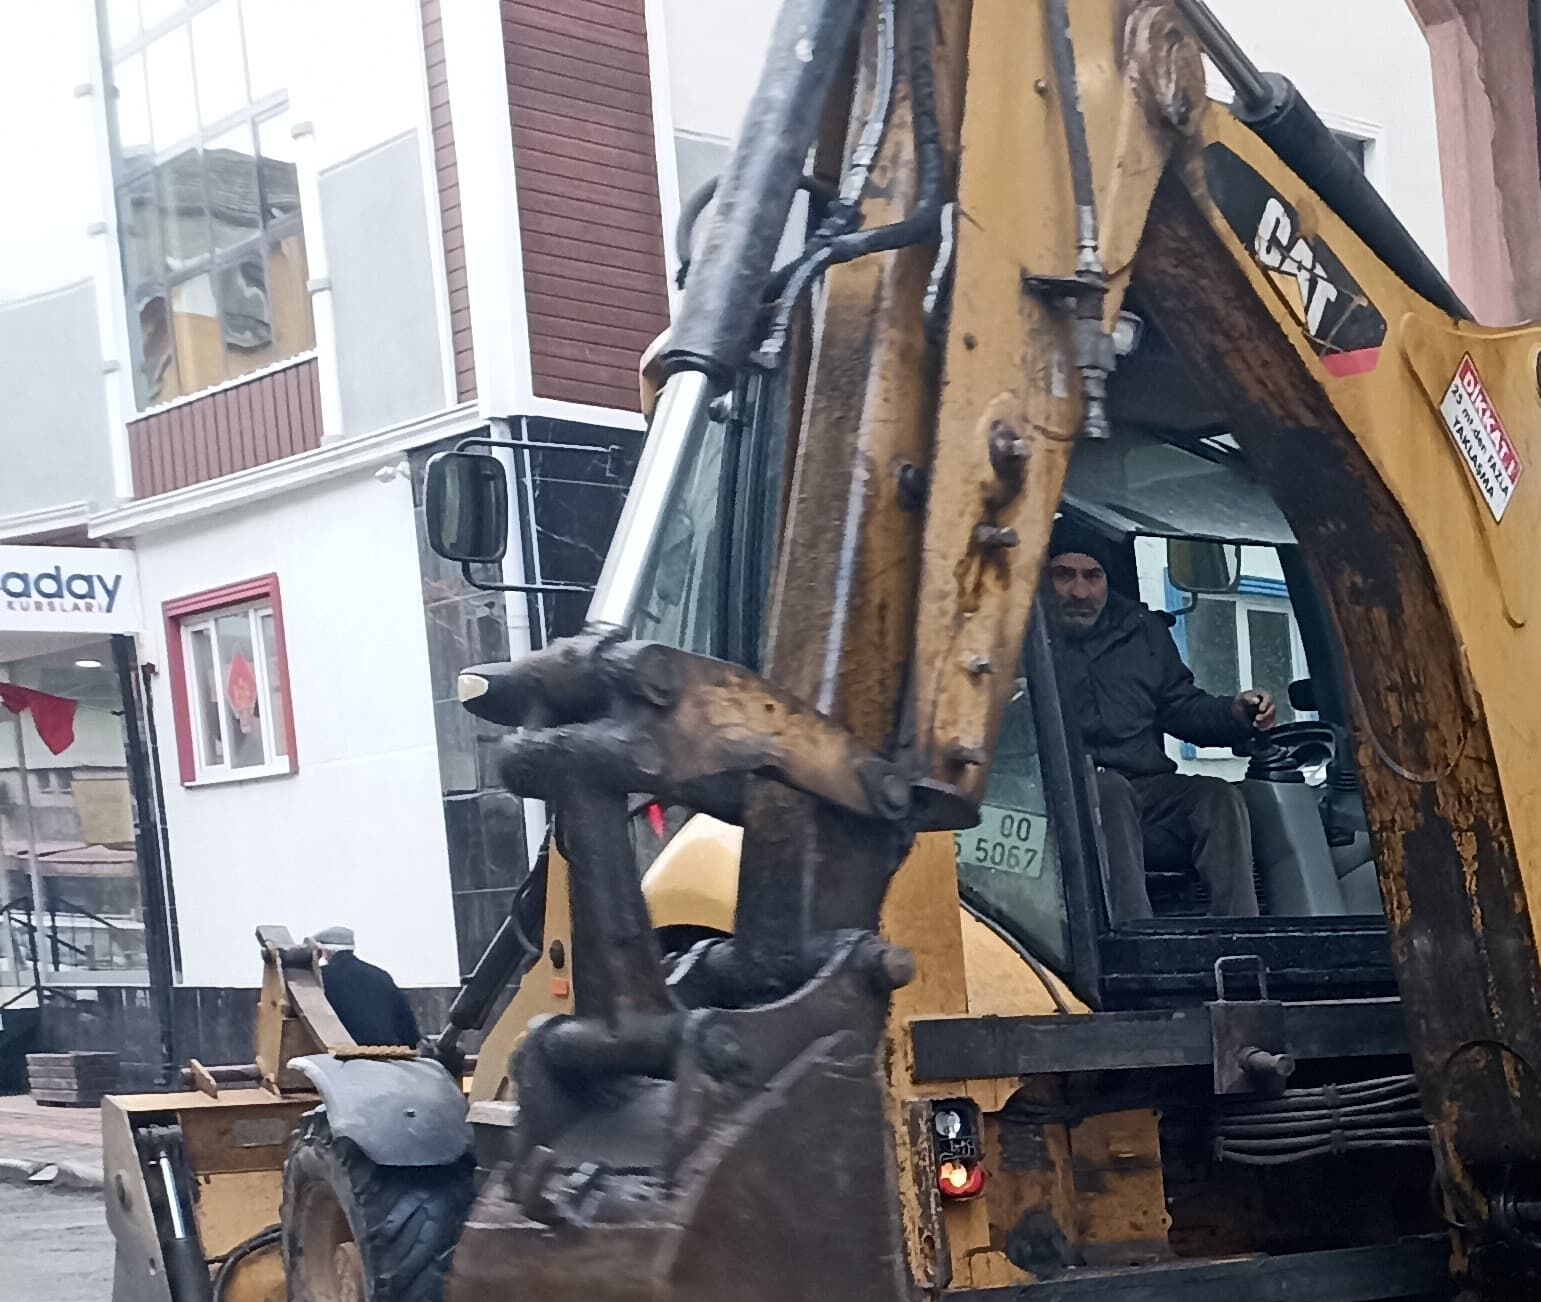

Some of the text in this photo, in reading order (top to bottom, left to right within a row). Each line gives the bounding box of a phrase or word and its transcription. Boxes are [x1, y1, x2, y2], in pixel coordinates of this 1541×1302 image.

[1255, 197, 1337, 336] CAT
[1000, 813, 1032, 842] 00
[975, 838, 1039, 872] 5067
